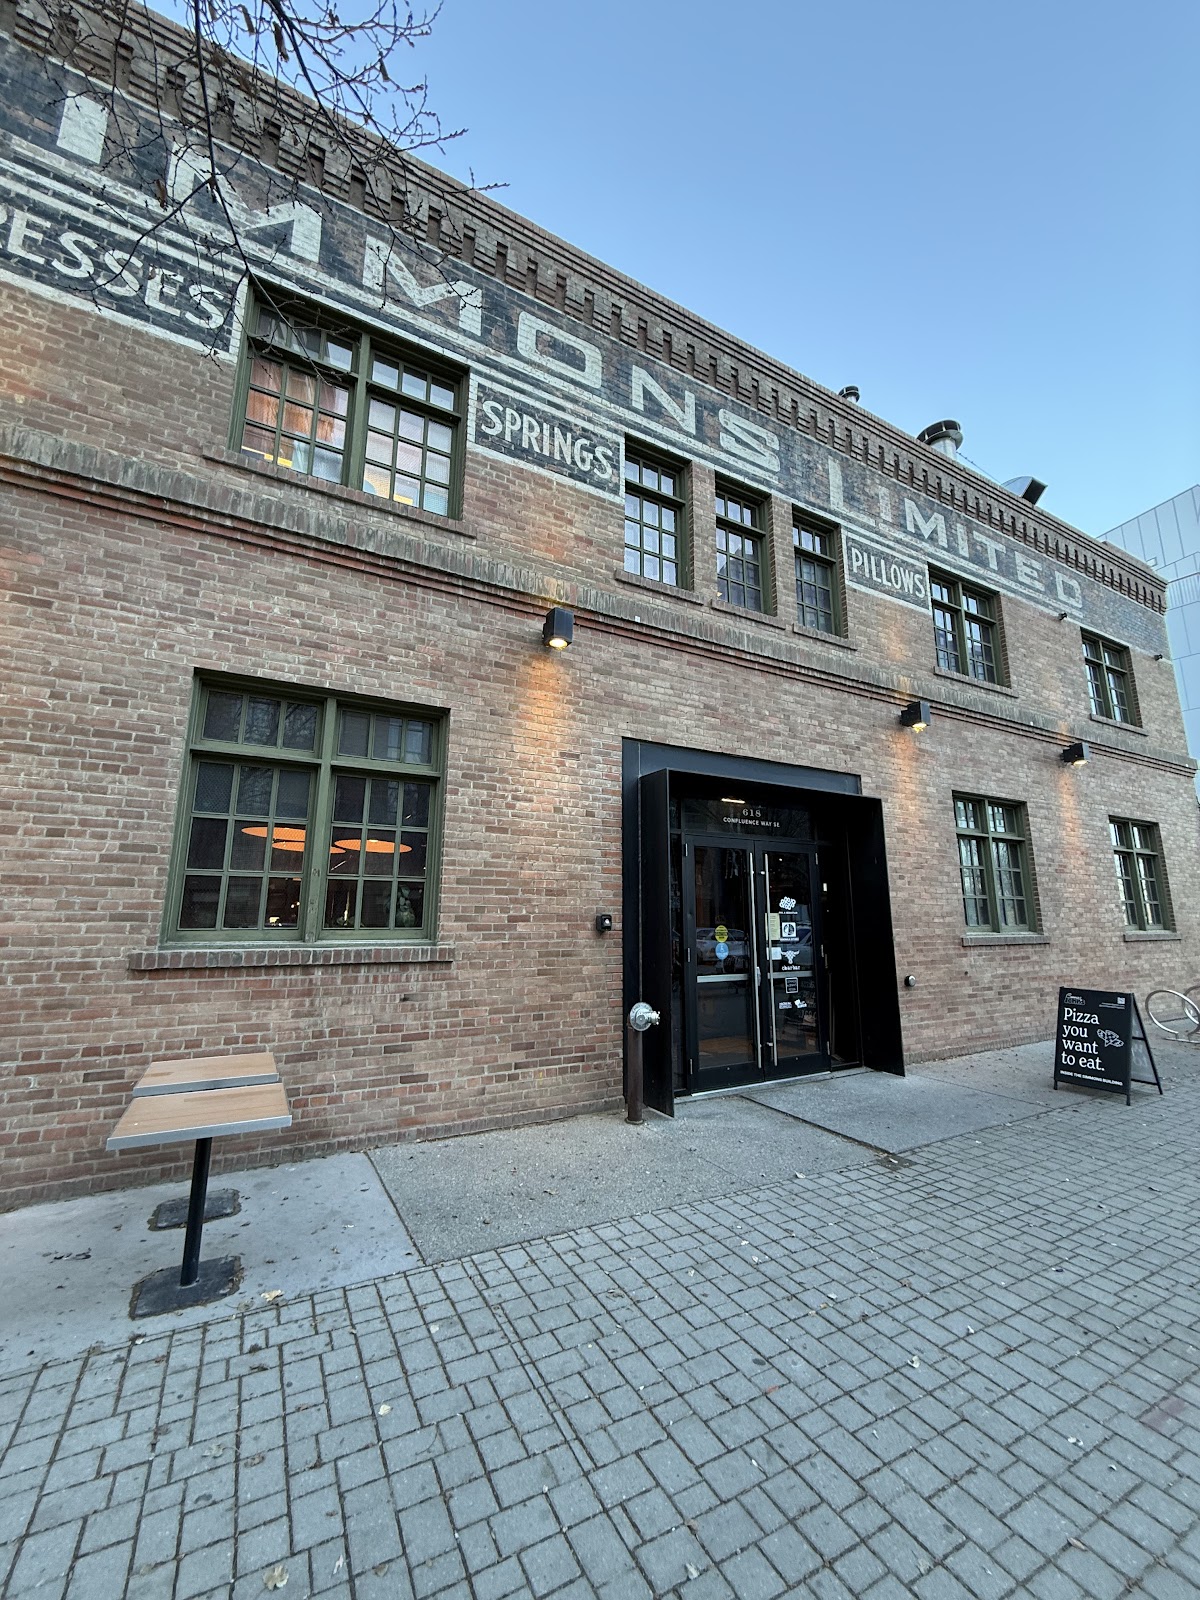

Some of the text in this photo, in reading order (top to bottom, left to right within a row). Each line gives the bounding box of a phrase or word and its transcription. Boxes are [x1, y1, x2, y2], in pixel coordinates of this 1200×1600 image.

[481, 400, 613, 479] SPRINGS
[828, 456, 1083, 609] LIMITED
[851, 547, 926, 599] PILLOWS
[722, 816, 760, 826] CONFLUENCE
[742, 808, 762, 818] 618
[1063, 1007, 1100, 1025] Pizza
[1062, 1024, 1088, 1038] you
[1062, 1039, 1099, 1054] want
[1061, 1051, 1105, 1071] to eat.
